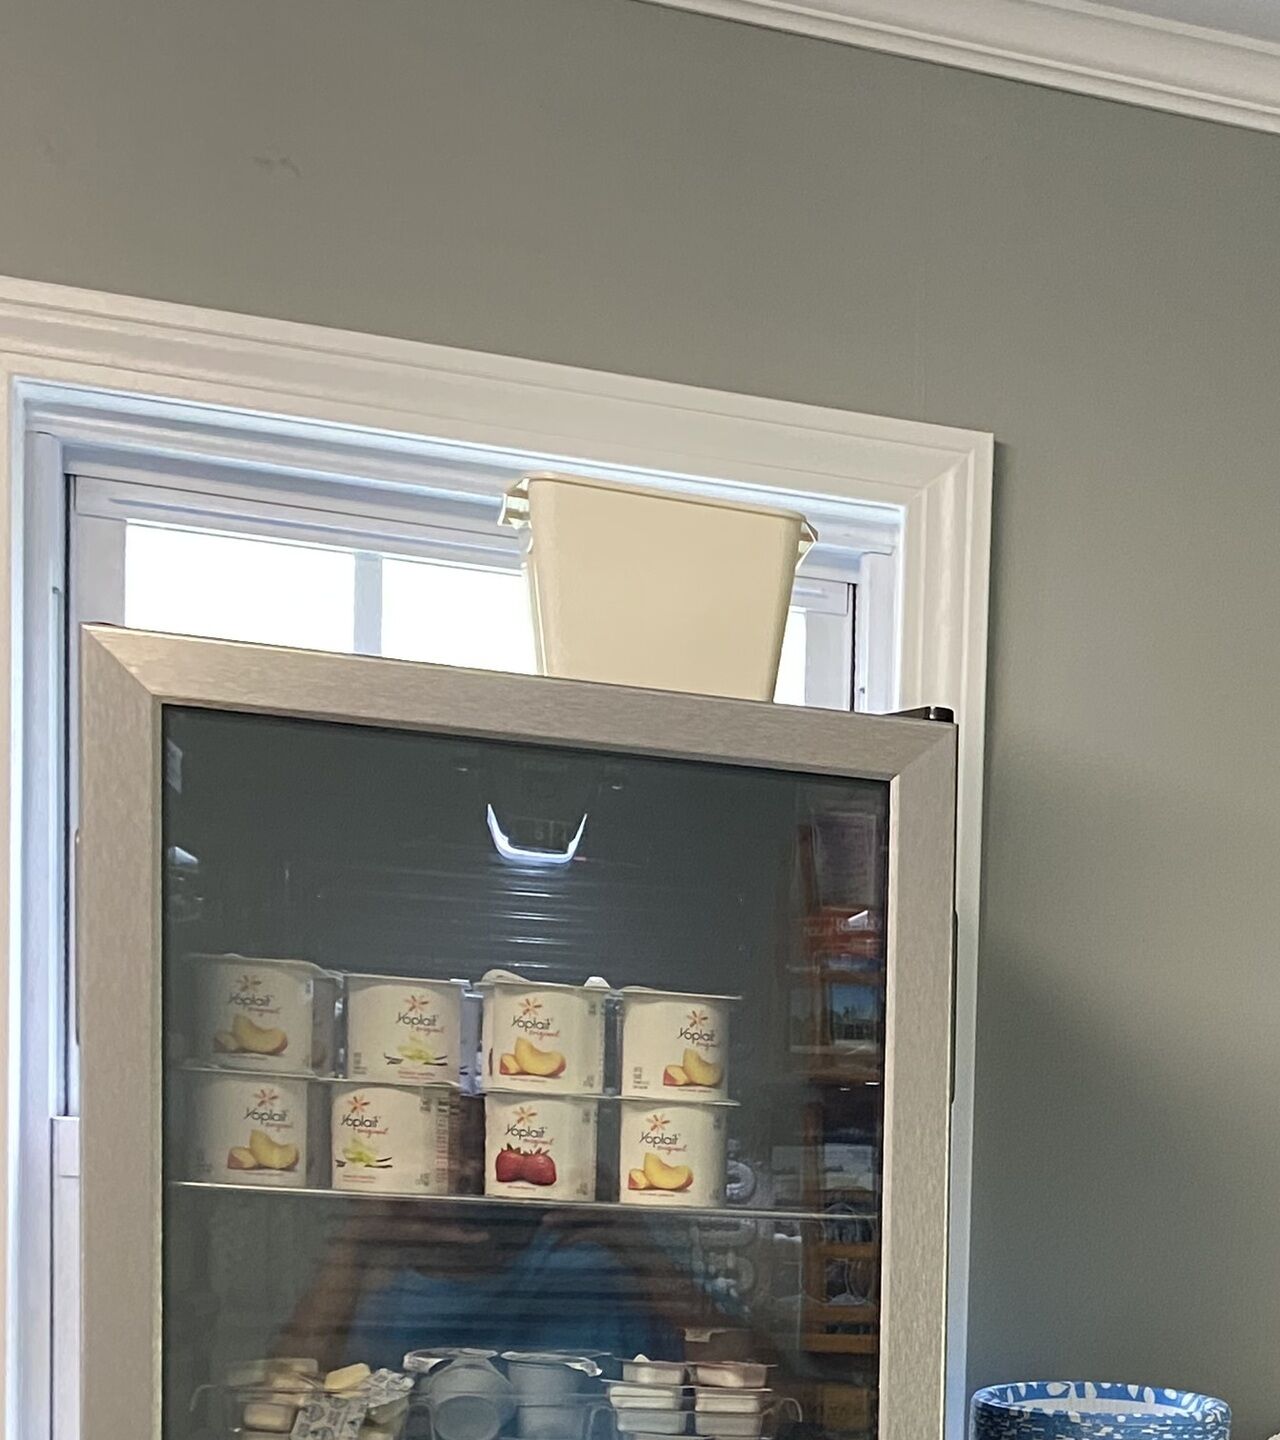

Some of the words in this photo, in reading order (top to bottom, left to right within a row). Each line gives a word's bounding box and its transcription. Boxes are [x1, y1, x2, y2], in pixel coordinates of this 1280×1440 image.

[395, 1010, 438, 1029] Yoplait
[511, 1014, 552, 1032] Yoplait
[678, 1026, 716, 1044] Yoplait
[243, 1105, 289, 1125] Yoplait
[341, 1112, 381, 1131] Yoplait
[505, 1122, 546, 1140] Yoplait
[639, 1130, 680, 1149] Yoplait
